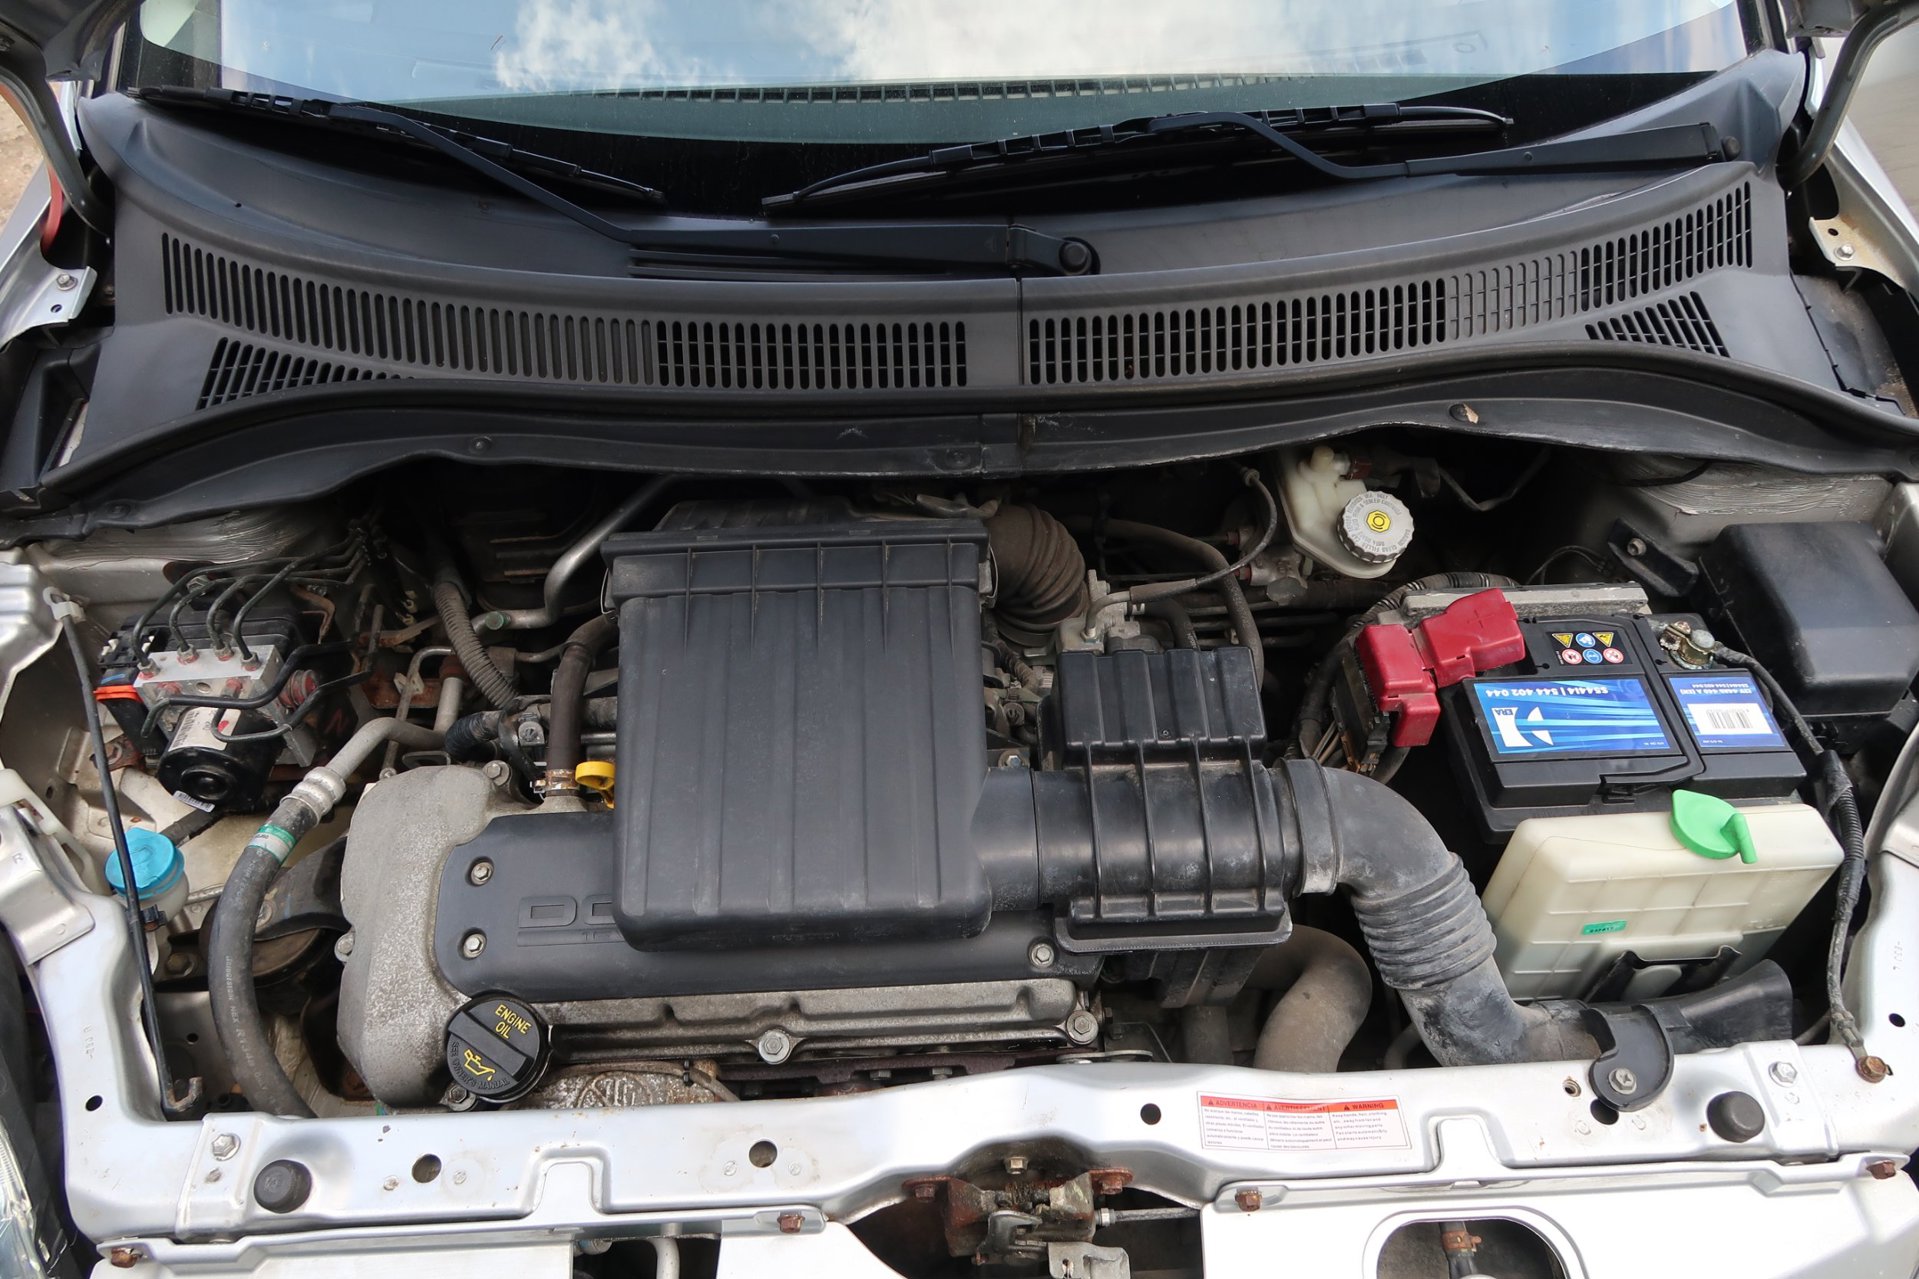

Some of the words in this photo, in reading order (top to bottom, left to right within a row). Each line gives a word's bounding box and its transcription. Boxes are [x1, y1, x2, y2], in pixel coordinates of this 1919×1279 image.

[1485, 689, 1509, 698] 044
[1512, 688, 1532, 697] 402
[1534, 687, 1557, 697] 544
[1493, 708, 1514, 716] ERA
[495, 1003, 531, 1034] ENGINE
[495, 1022, 512, 1039] OIL
[450, 1041, 460, 1057] SEE
[452, 1057, 478, 1088] OWNER'S
[478, 1078, 511, 1090] MANUAL
[1215, 1100, 1257, 1108] ADVERTENCIA
